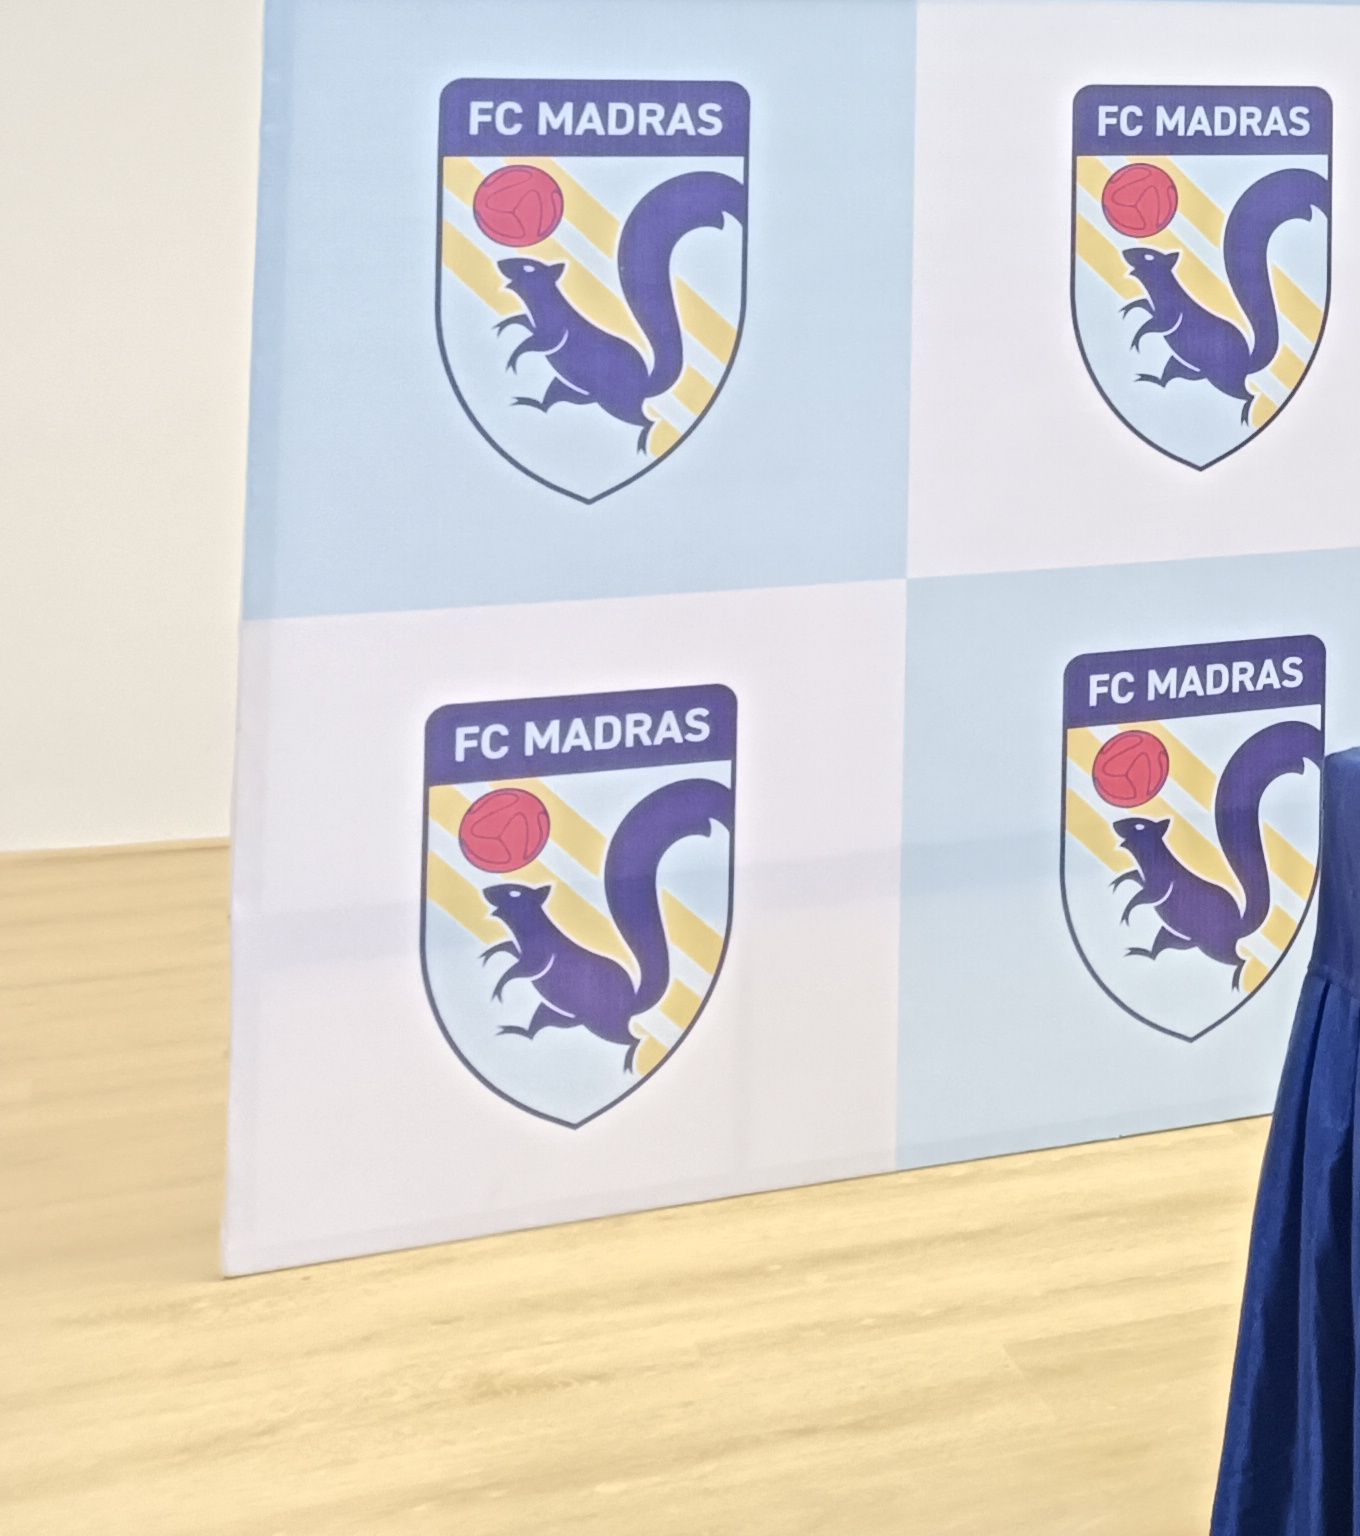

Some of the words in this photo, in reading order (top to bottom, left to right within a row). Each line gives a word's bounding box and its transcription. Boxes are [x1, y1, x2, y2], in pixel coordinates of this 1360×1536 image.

[469, 100, 523, 136] FC
[538, 101, 723, 137] MADRAS
[1097, 105, 1143, 137] FC
[1155, 105, 1311, 137] MADRAS
[1089, 671, 1135, 707] FC
[1147, 656, 1304, 701] MADRAS
[454, 723, 509, 762] FC
[524, 707, 711, 757] MADRAS
